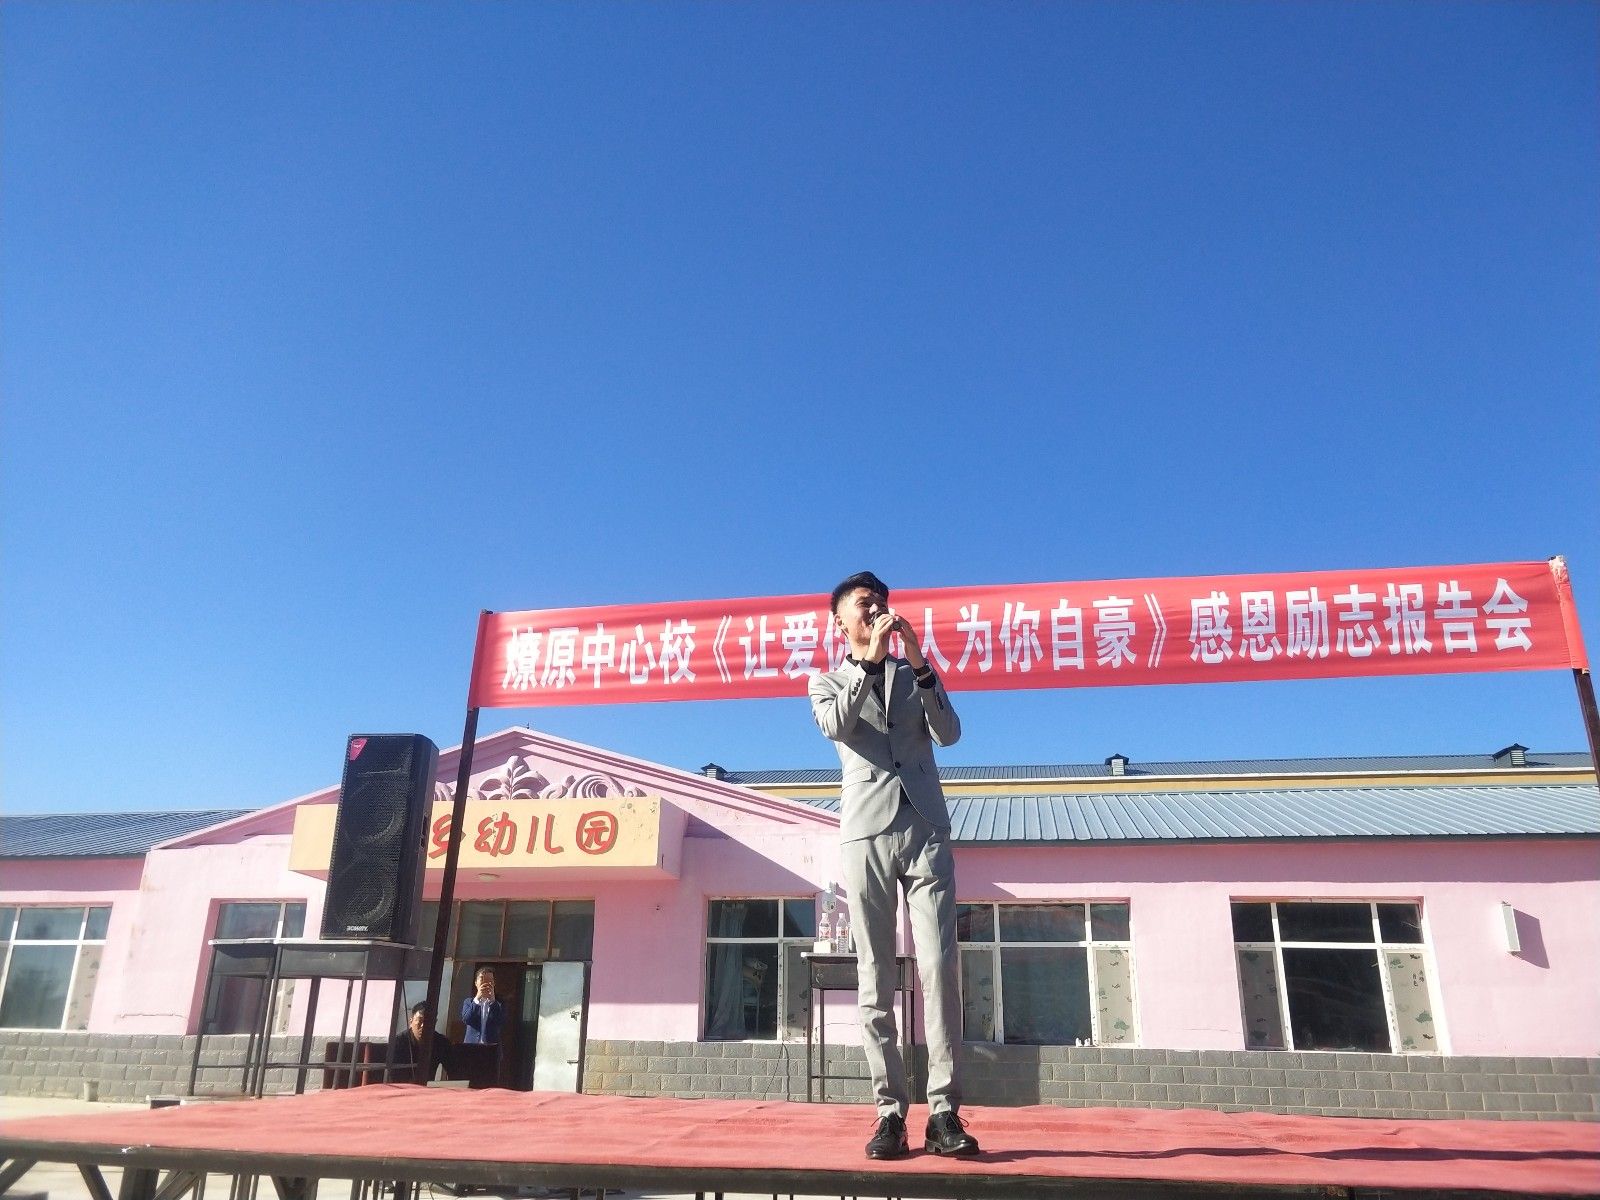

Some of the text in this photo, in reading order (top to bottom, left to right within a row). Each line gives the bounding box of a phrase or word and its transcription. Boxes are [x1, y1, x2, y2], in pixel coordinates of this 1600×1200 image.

[502, 578, 1534, 691] 燎原中心校《让爱你人为你自豪》感恩励志报告会
